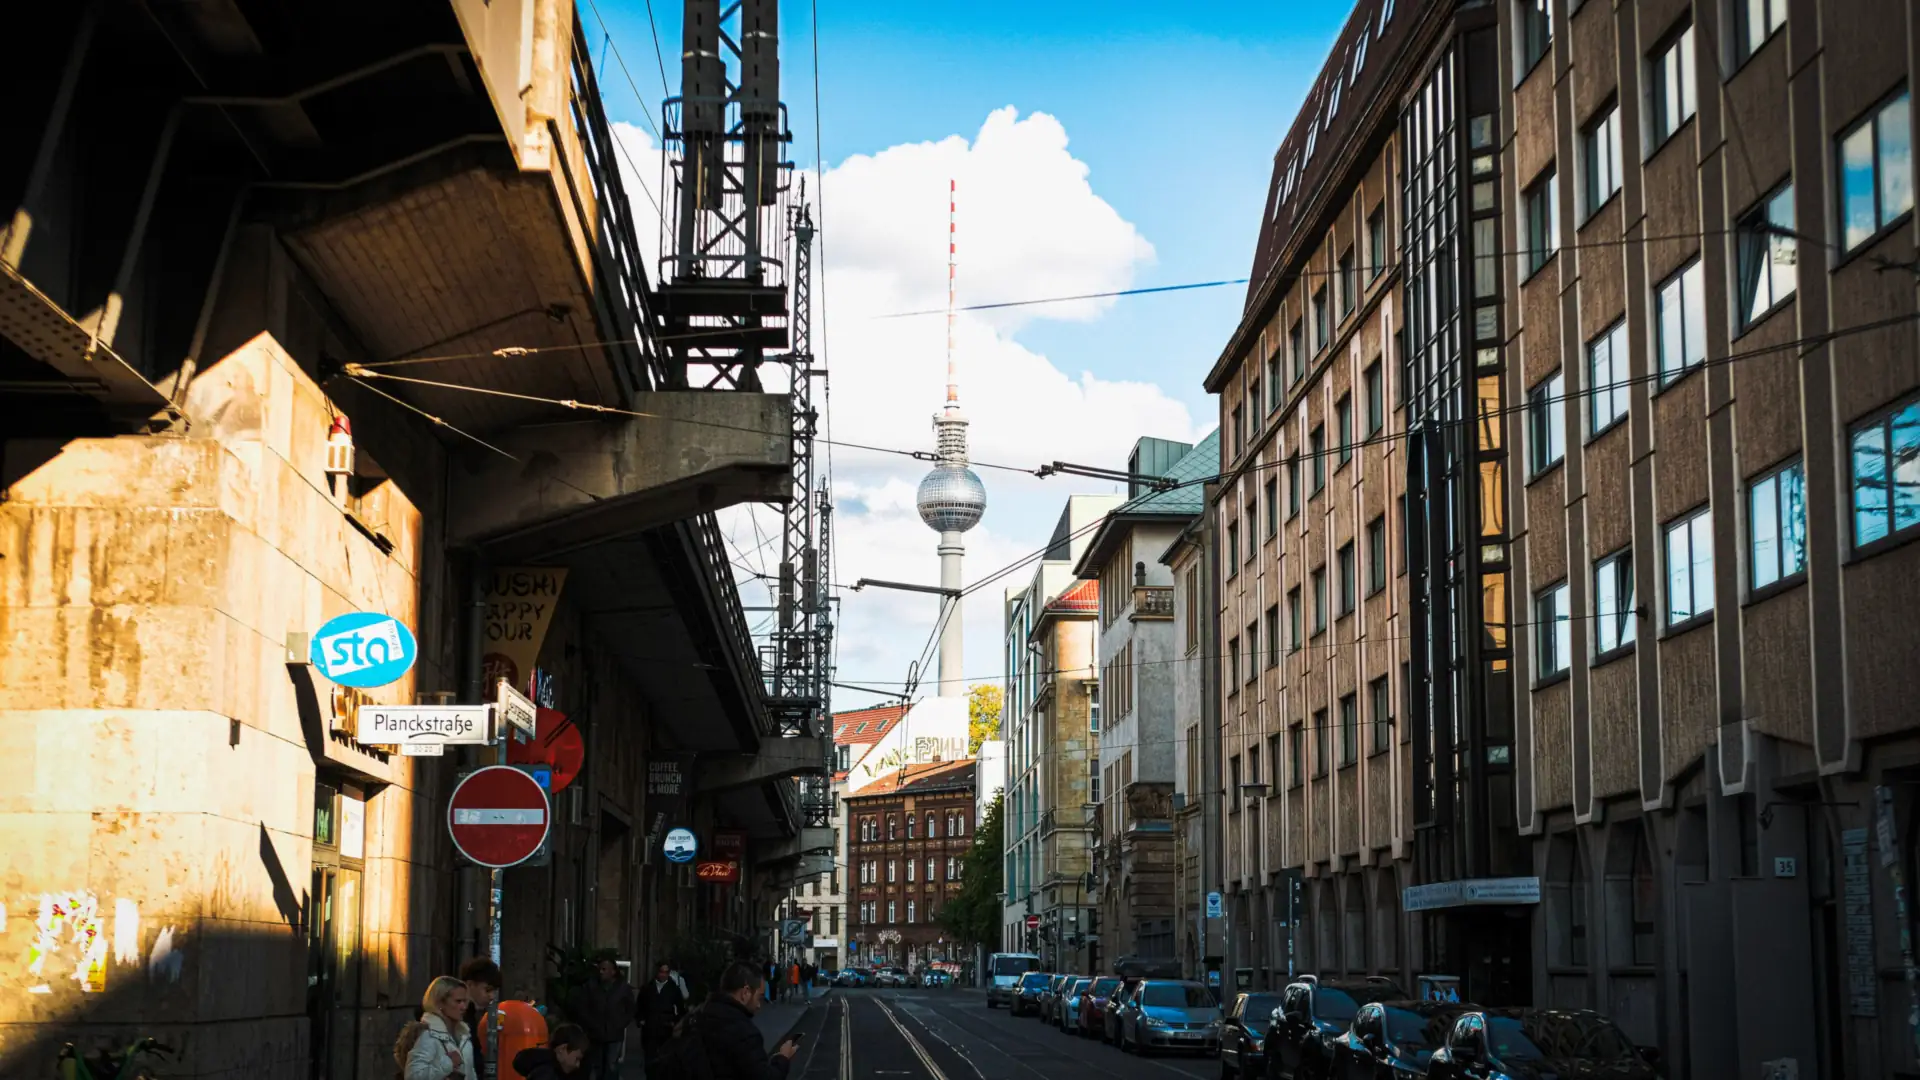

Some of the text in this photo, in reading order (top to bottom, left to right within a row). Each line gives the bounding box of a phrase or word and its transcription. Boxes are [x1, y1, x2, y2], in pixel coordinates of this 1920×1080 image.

[486, 602, 545, 620] APPY
[487, 623, 532, 641] OUR
[330, 632, 389, 666] sta
[374, 714, 473, 735] Planckstraße
[648, 761, 679, 772] COFFEE
[648, 773, 682, 783] BRUNCH
[657, 784, 680, 795] MORE
[1779, 861, 1793, 873] 35
